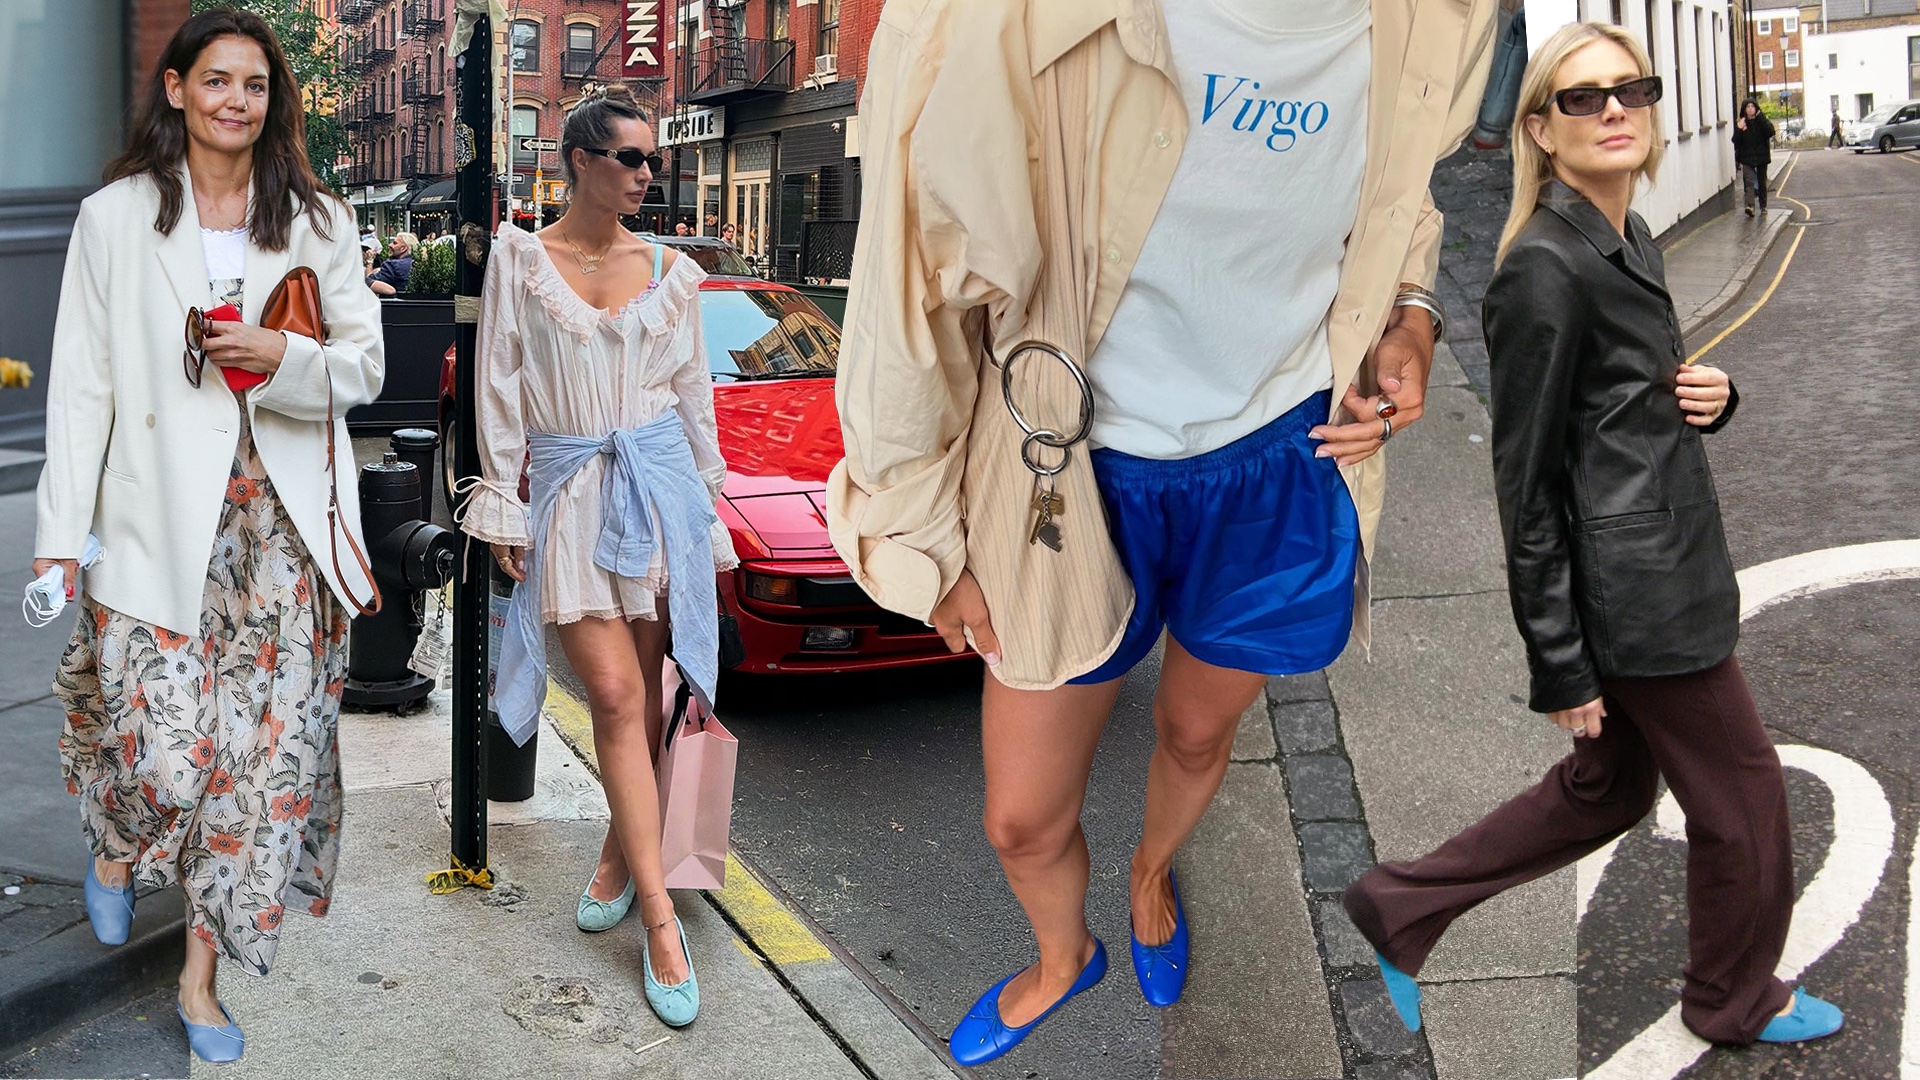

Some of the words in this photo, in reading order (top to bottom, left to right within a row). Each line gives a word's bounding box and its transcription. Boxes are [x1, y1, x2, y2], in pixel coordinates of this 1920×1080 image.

[625, 1, 659, 67] ZZA
[667, 113, 714, 140] UPSIDE
[1202, 73, 1329, 152] Virgo
